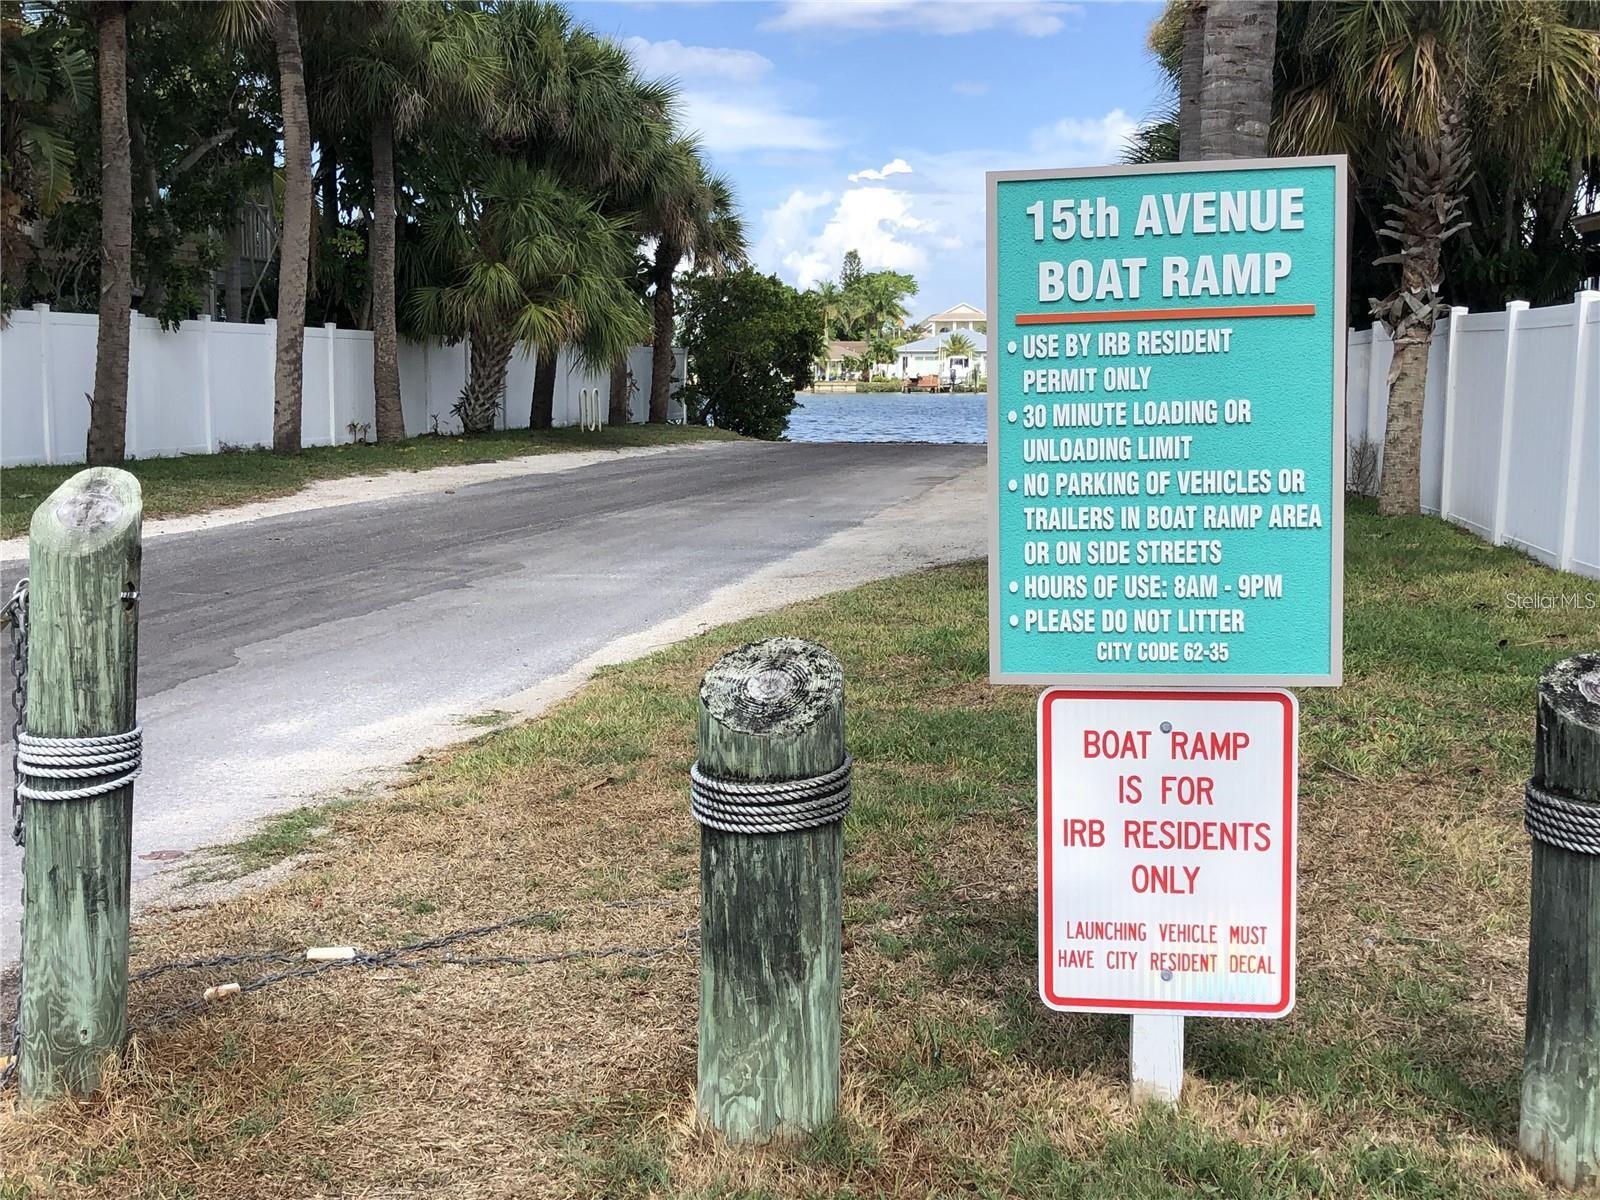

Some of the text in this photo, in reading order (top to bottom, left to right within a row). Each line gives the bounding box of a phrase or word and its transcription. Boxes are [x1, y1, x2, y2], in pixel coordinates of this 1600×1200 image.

[1026, 188, 1305, 241] 15th AVENUE
[1038, 252, 1292, 302] BOAT RAMP
[1023, 328, 1232, 358] USE BY IRB RESIDENT
[1023, 366, 1152, 393] PERMIT ONLY
[1023, 399, 1252, 428] 30 MINUTE LOADING OR
[1023, 436, 1192, 462] UNLOADING LIMIT
[1024, 468, 1306, 497] NO PARKING OF VEHICLES OR
[1024, 504, 1322, 530] TRAILERS IN BOAT RAMP AREA
[1024, 540, 1222, 565] OR ON SIDE STREETS
[1024, 576, 1088, 599] HOURS
[1093, 575, 1118, 598] OF
[1125, 575, 1168, 598] USE:
[1173, 574, 1218, 598] 8AM
[1238, 574, 1283, 598] 9PM
[1025, 609, 1245, 632] PLEASE DO NOT LITTER
[1097, 642, 1229, 661] CITY CODE 62-35
[1083, 730, 1250, 761] BOAT RAMP
[1118, 775, 1214, 805] IS FOR
[1063, 819, 1271, 851] IRB RESIDENTS
[1132, 864, 1200, 894] ONLY
[1066, 921, 1268, 945] LAUNCHING VEHICLE MUST
[1058, 950, 1275, 974] HAVE CITY RESIDENT DECAL
